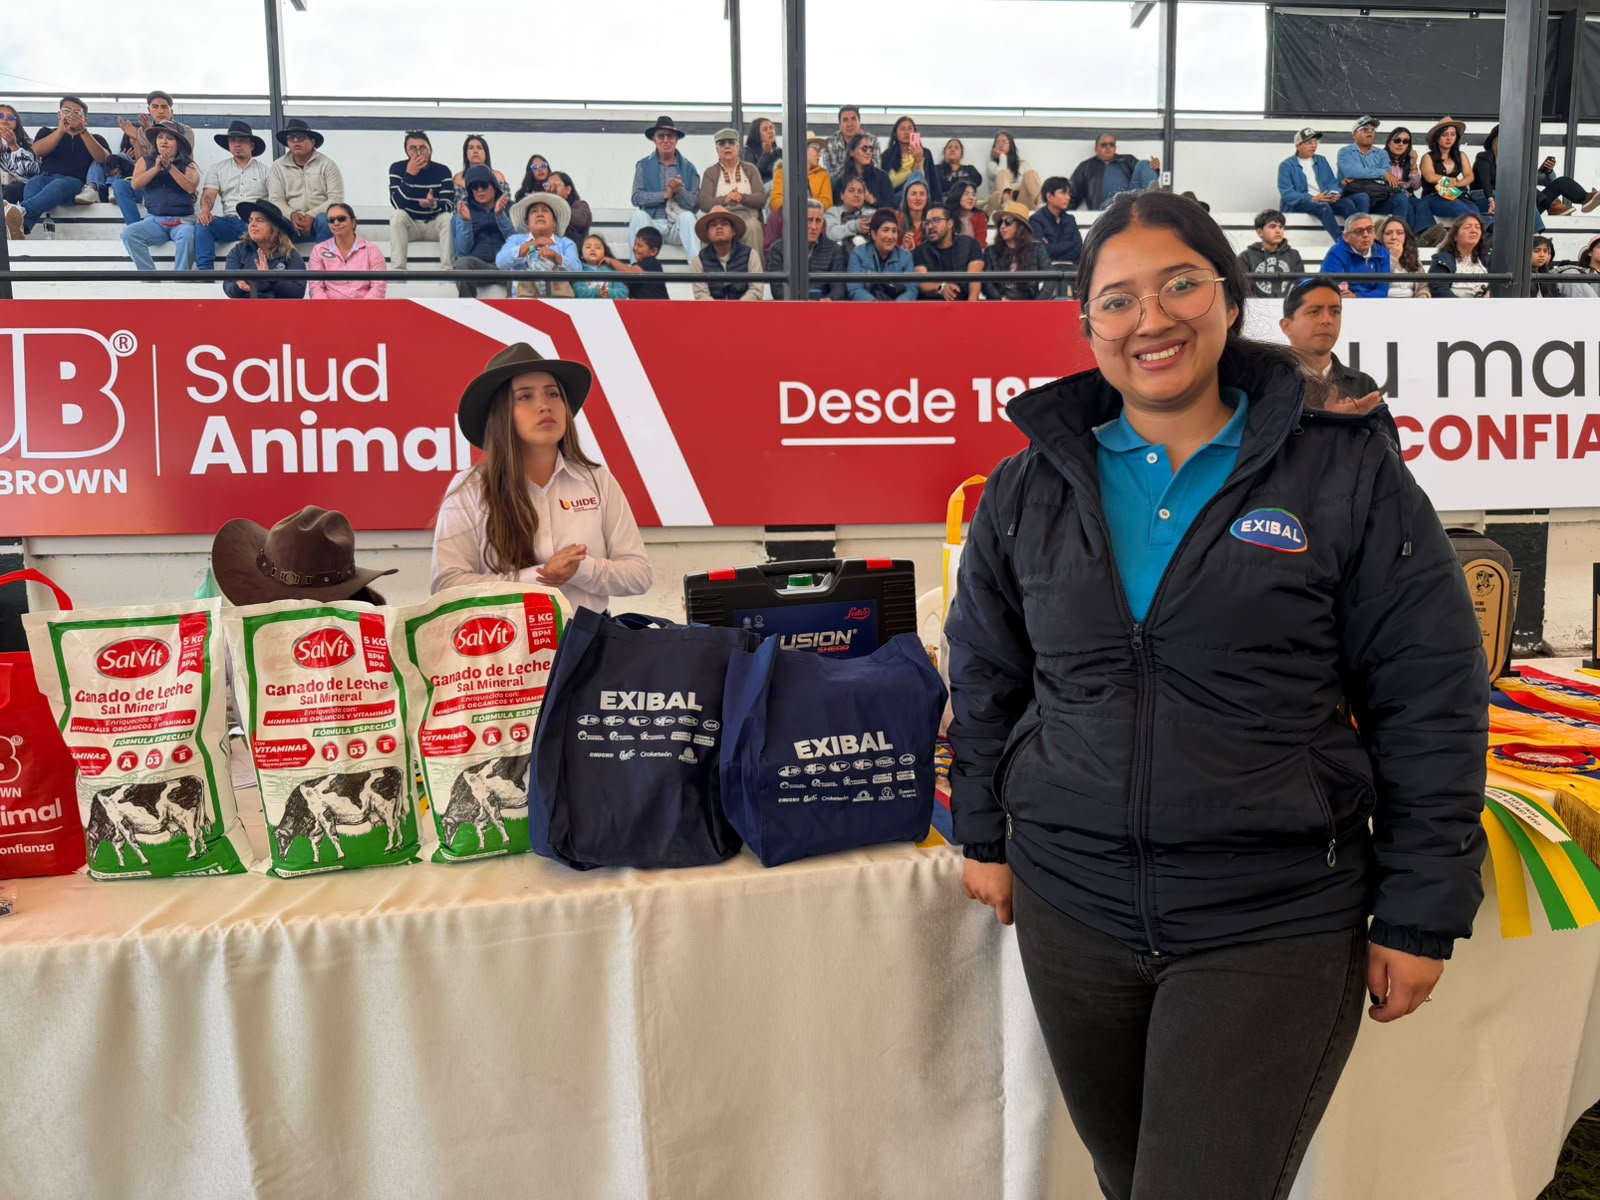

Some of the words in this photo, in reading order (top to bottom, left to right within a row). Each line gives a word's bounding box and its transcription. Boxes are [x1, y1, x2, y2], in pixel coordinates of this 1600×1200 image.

[186, 343, 388, 404] Salud
[1348, 341, 1398, 398] u
[1437, 340, 1600, 398] ma
[779, 378, 956, 425] Desde
[190, 410, 472, 475] Animal
[1241, 519, 1302, 544] EXIBAL
[538, 612, 554, 622] KG
[532, 629, 551, 638] BPM
[191, 634, 204, 645] KG
[371, 637, 386, 647] KG
[533, 637, 551, 646] BPA
[780, 630, 852, 650] USION
[367, 652, 385, 661] BPM
[369, 660, 386, 668] BPA
[430, 666, 481, 687] Ganado
[485, 664, 504, 676] de
[508, 660, 551, 676] Leche
[265, 679, 324, 697] Ganado
[327, 677, 343, 691] de
[346, 677, 389, 691] Leche
[457, 682, 474, 693] Sal
[477, 676, 524, 690] Mineral
[75, 689, 131, 704] Ganado
[135, 687, 154, 701] de
[157, 681, 193, 699] Leche
[461, 692, 503, 703] Enriquecido
[300, 693, 317, 706] Sal
[319, 691, 362, 704] Mineral
[600, 690, 703, 711] EXIBAL
[101, 703, 121, 715] Sal
[124, 699, 168, 714] Mineral
[354, 708, 392, 718] VITAMINAS
[353, 721, 394, 733] ESPECIAL
[487, 733, 497, 744] A
[512, 729, 527, 739] D3
[254, 744, 307, 754] VITAMINAS
[383, 742, 390, 751] E
[794, 731, 893, 759] EXIBAL
[326, 749, 335, 760] A
[349, 746, 365, 756] D3
[121, 758, 132, 769] A
[147, 756, 160, 765] D3
[0, 797, 63, 826] imal
[0, 843, 55, 855] onfianza
